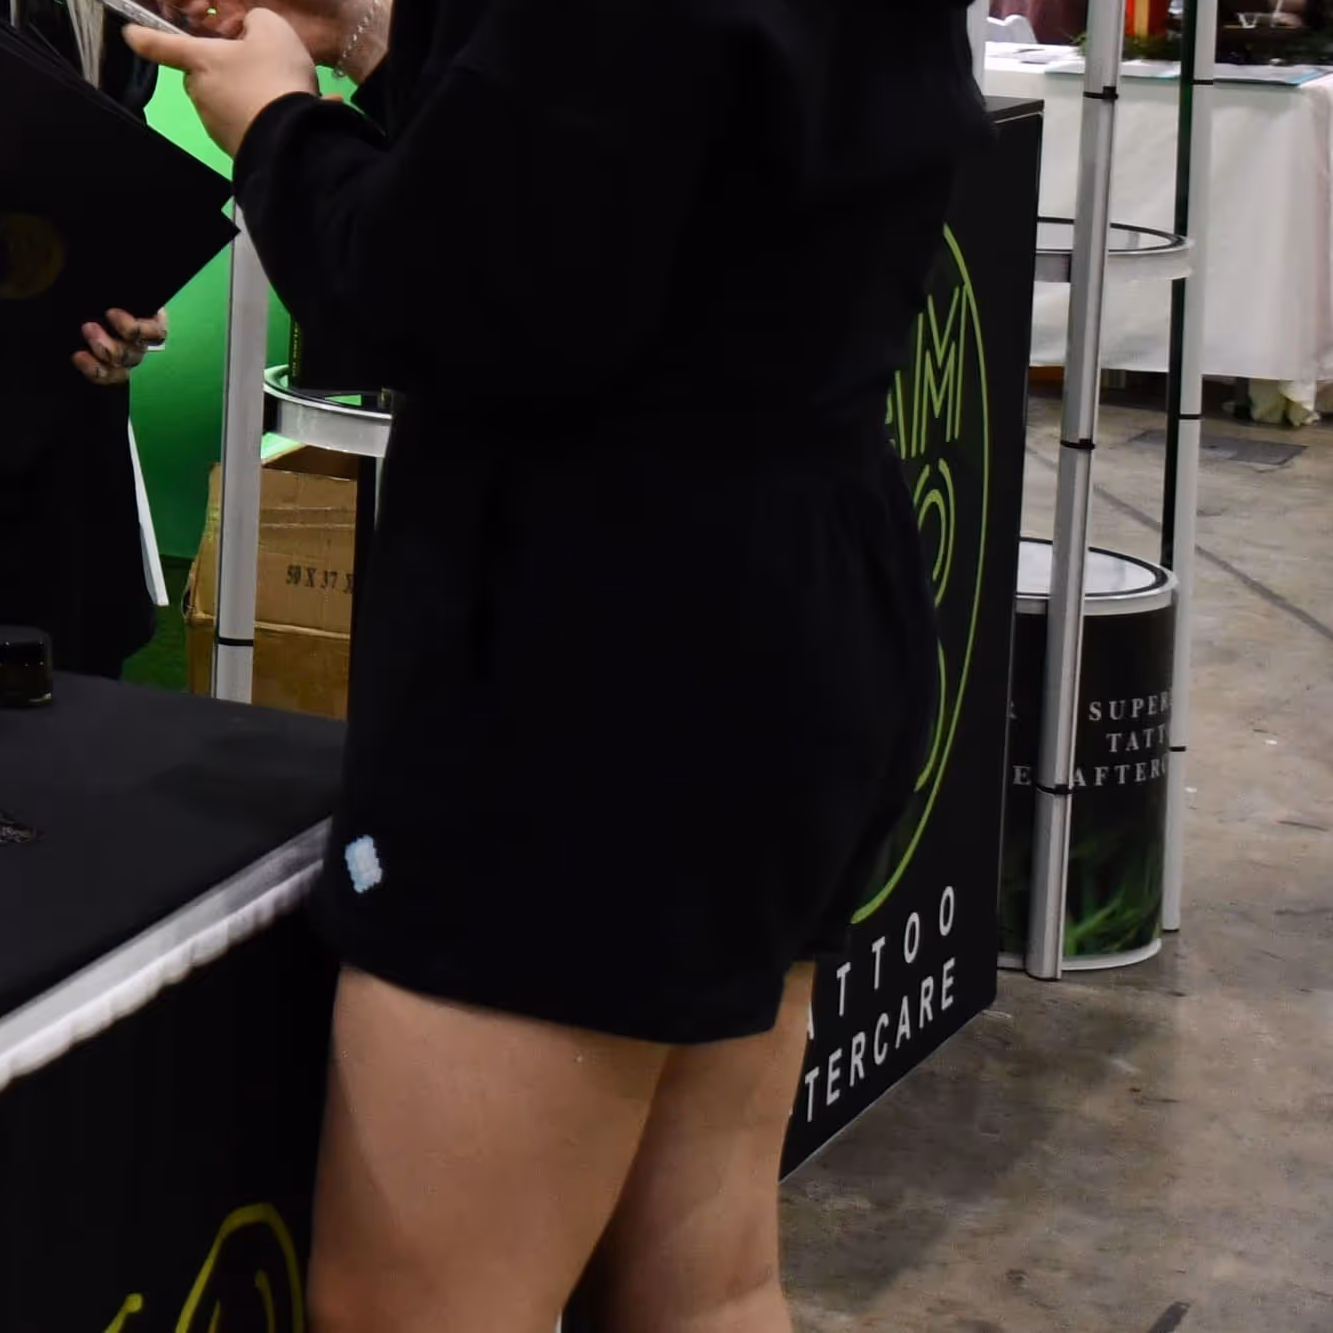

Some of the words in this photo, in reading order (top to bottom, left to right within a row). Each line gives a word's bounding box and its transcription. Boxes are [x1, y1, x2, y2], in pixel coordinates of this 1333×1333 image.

[1088, 692, 1173, 721] SUPER
[1106, 724, 1166, 753] TATT
[1072, 758, 1166, 787] AFTER
[807, 886, 955, 1040] TTOO
[789, 958, 955, 1122] TERCARE
